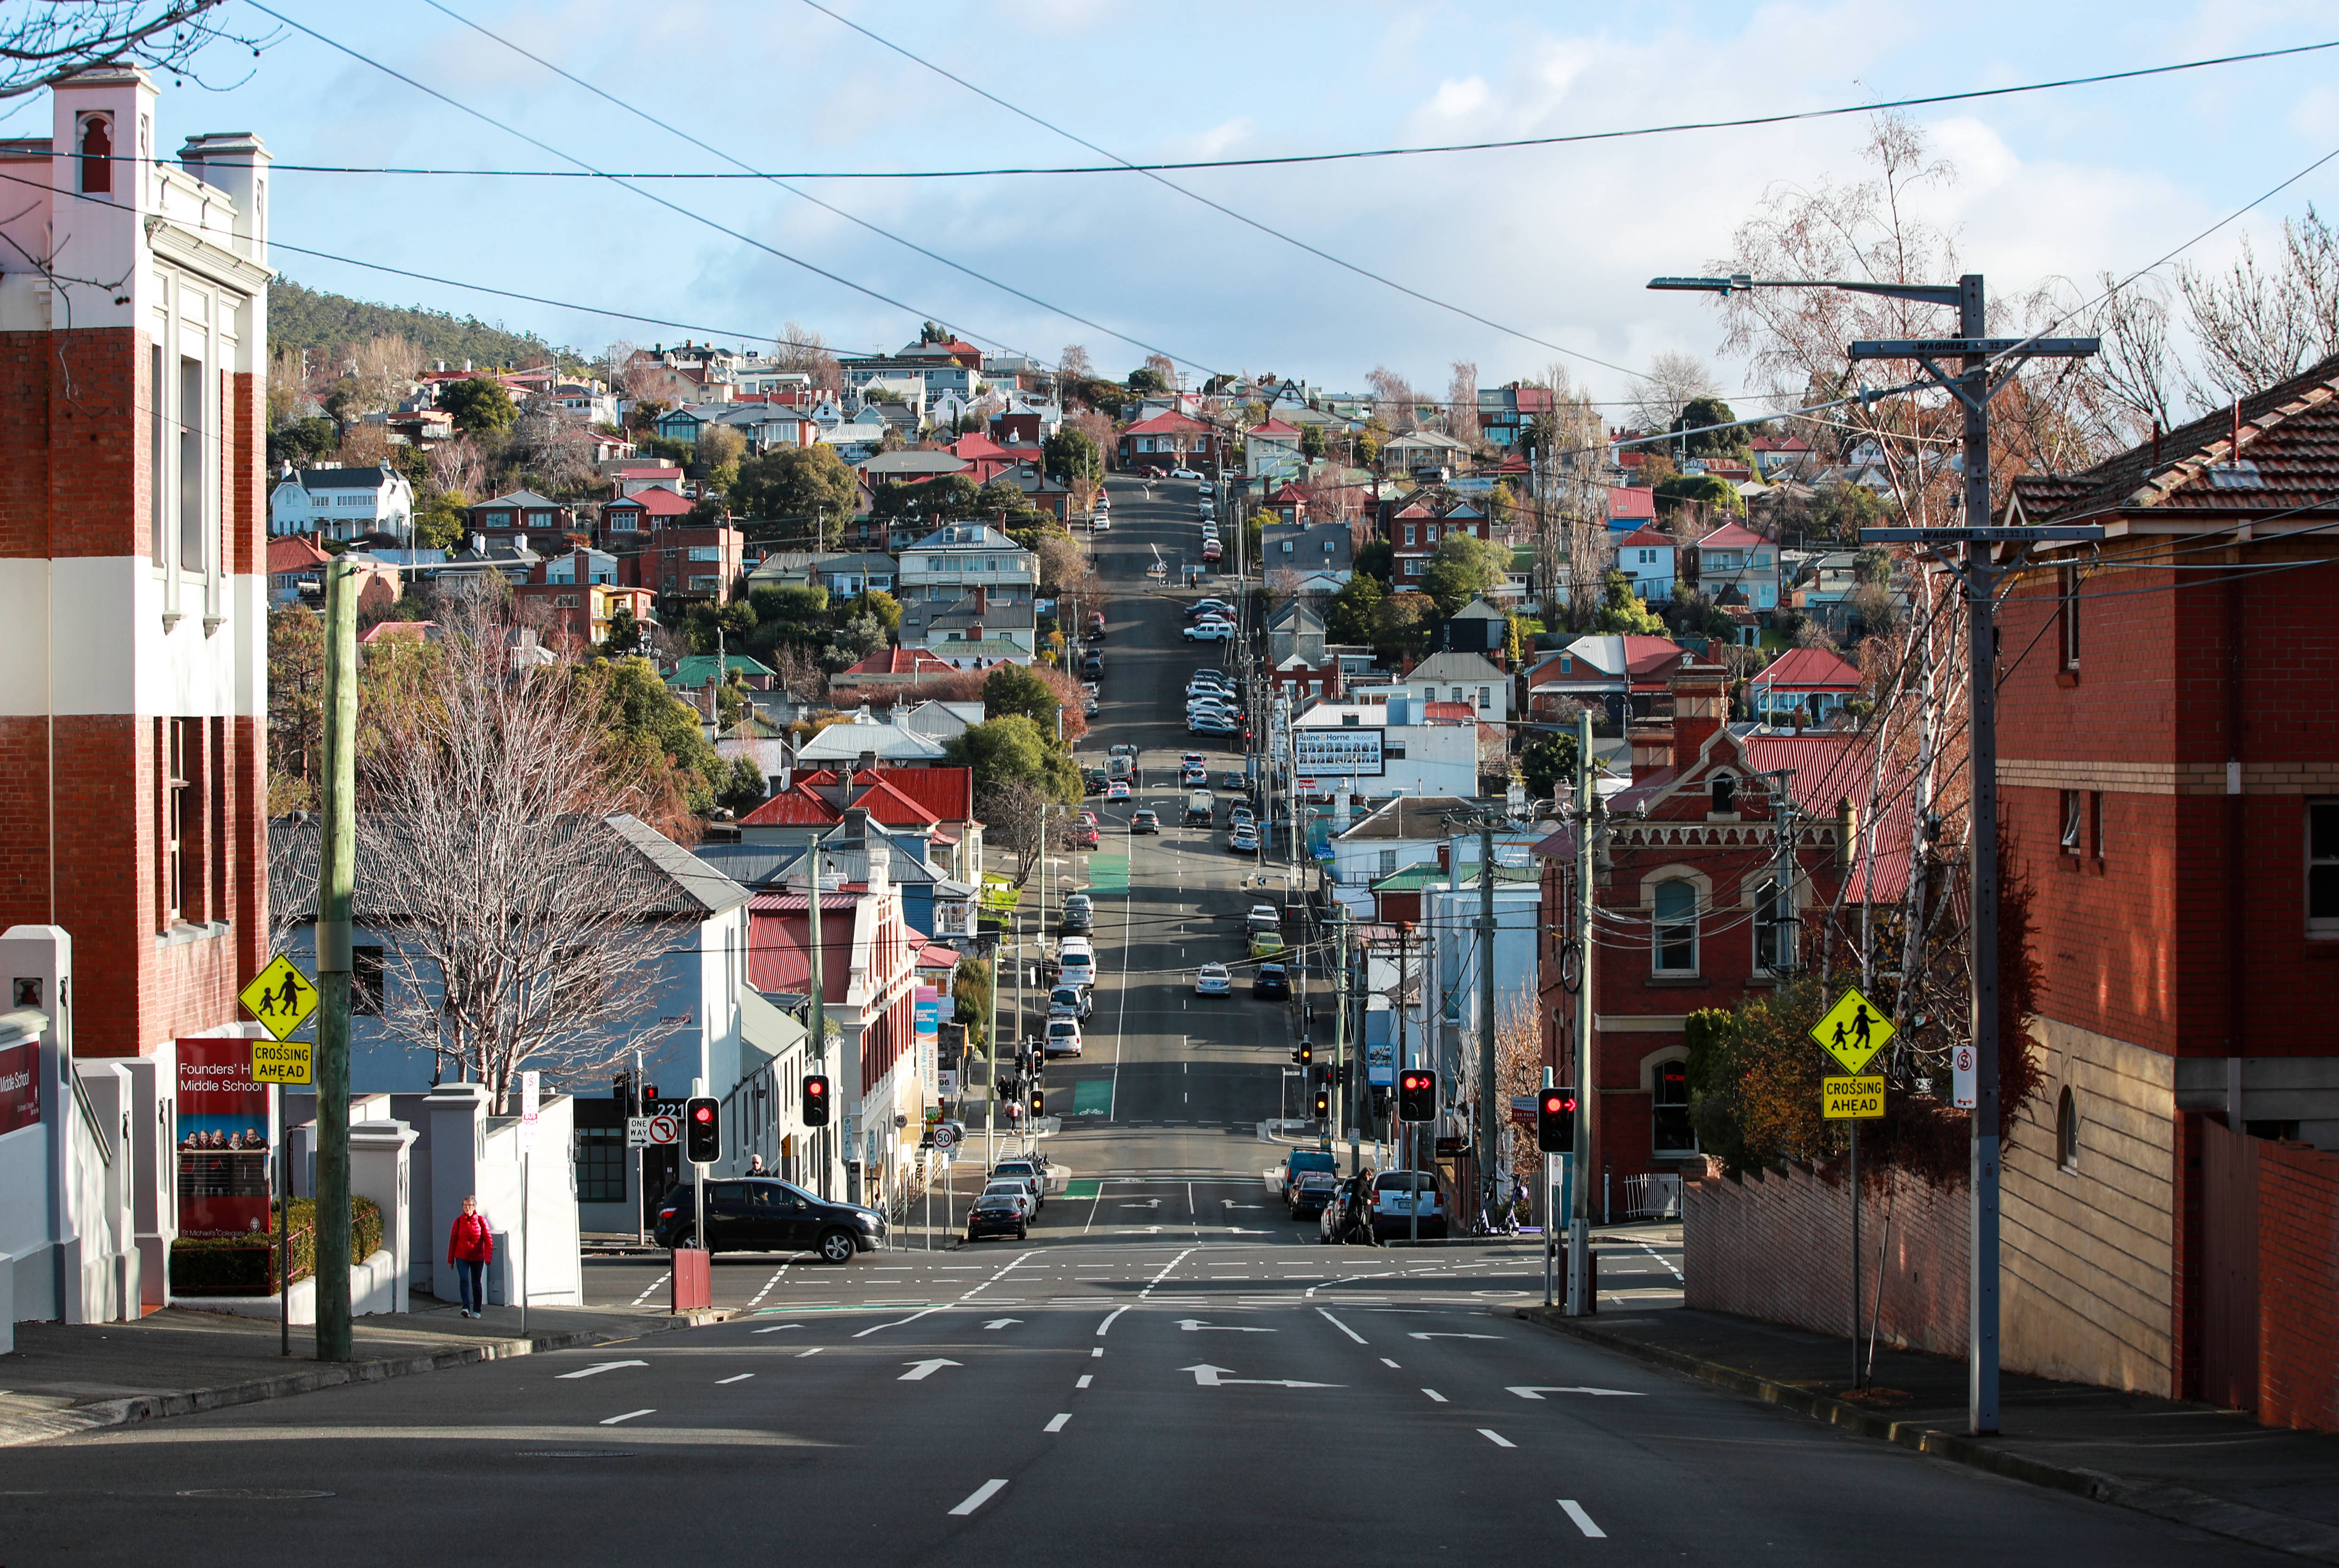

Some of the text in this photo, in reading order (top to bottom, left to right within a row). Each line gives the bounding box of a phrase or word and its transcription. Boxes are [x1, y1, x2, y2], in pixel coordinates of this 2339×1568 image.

[255, 1047, 309, 1061] CROSSING
[259, 1064, 304, 1077] AHEAD
[0, 1069, 30, 1093] Middle School
[181, 1080, 262, 1091] Middle School
[1826, 1082, 1881, 1095] CROSSING
[658, 1104, 684, 1117] 221
[1831, 1099, 1877, 1111] AHEAD
[938, 1134, 949, 1142] 50
